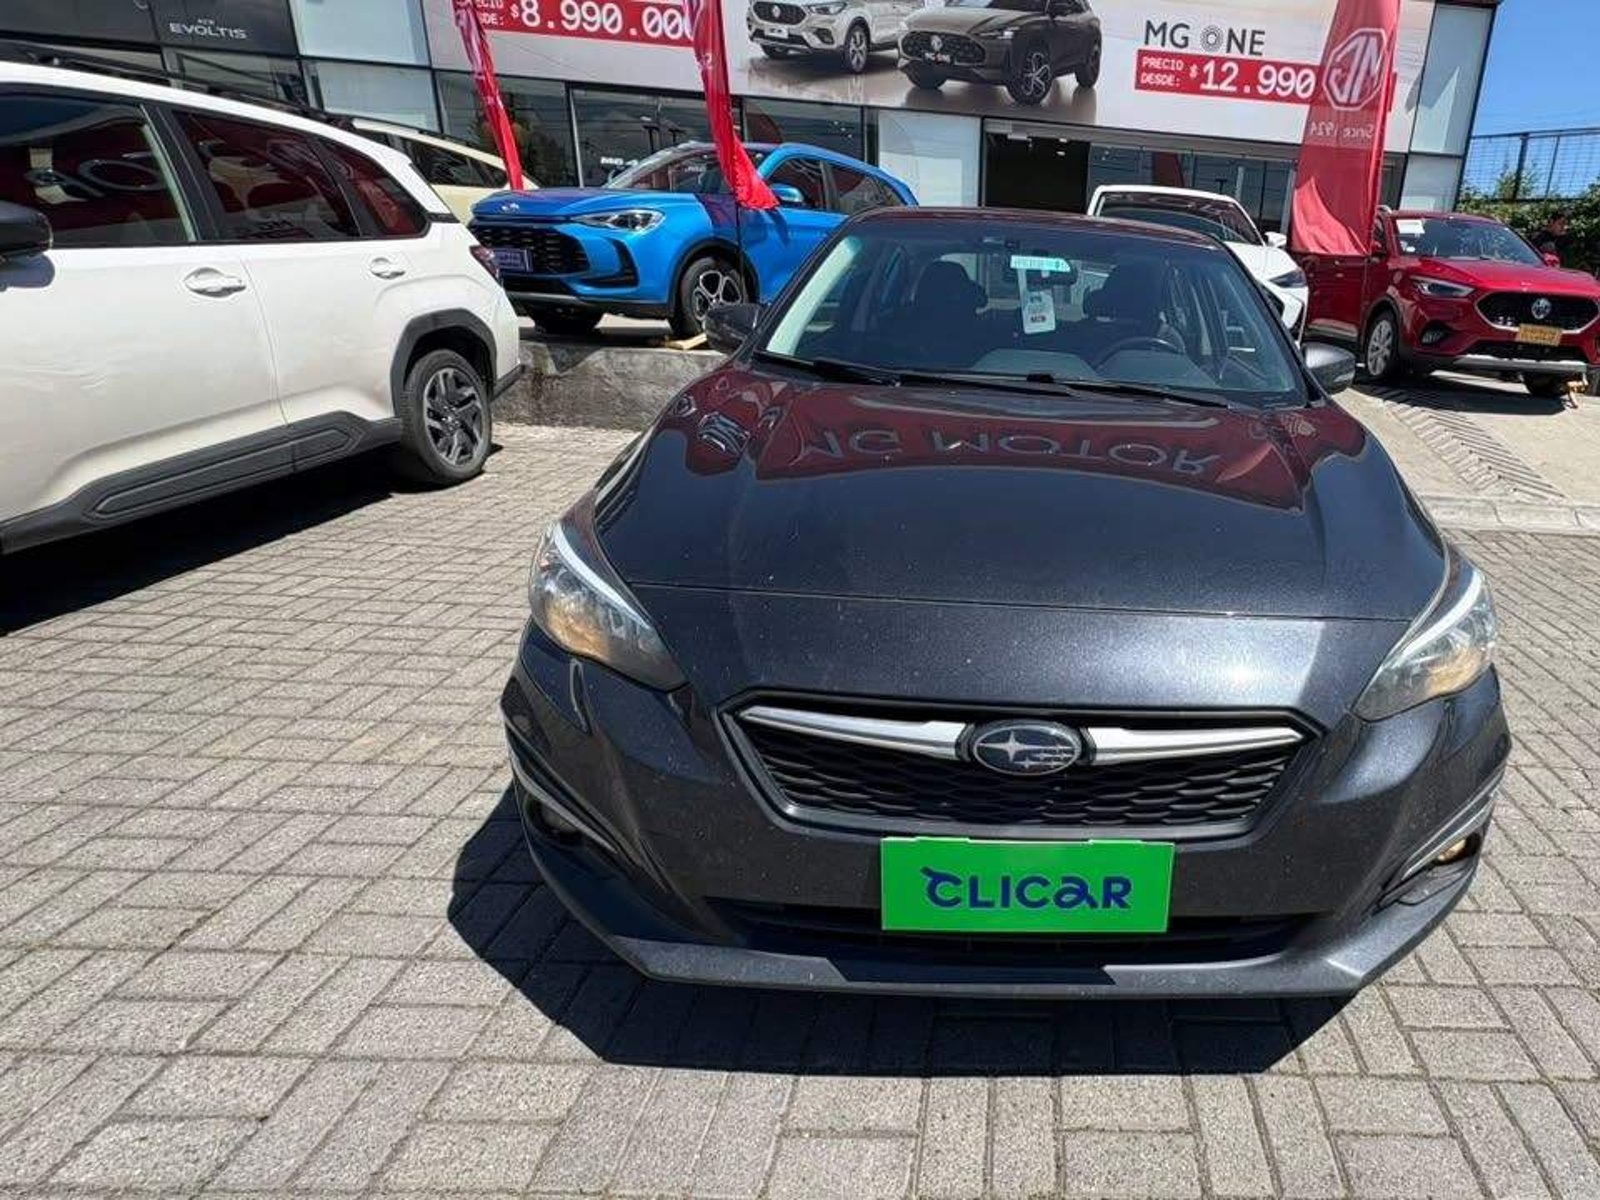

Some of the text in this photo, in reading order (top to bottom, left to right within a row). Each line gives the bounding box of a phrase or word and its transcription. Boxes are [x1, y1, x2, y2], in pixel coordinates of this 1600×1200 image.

[169, 22, 247, 39] EVOLTIS
[1144, 20, 1190, 49] MG
[1142, 57, 1184, 71] PRECIO
[1140, 72, 1182, 87] DESDE:
